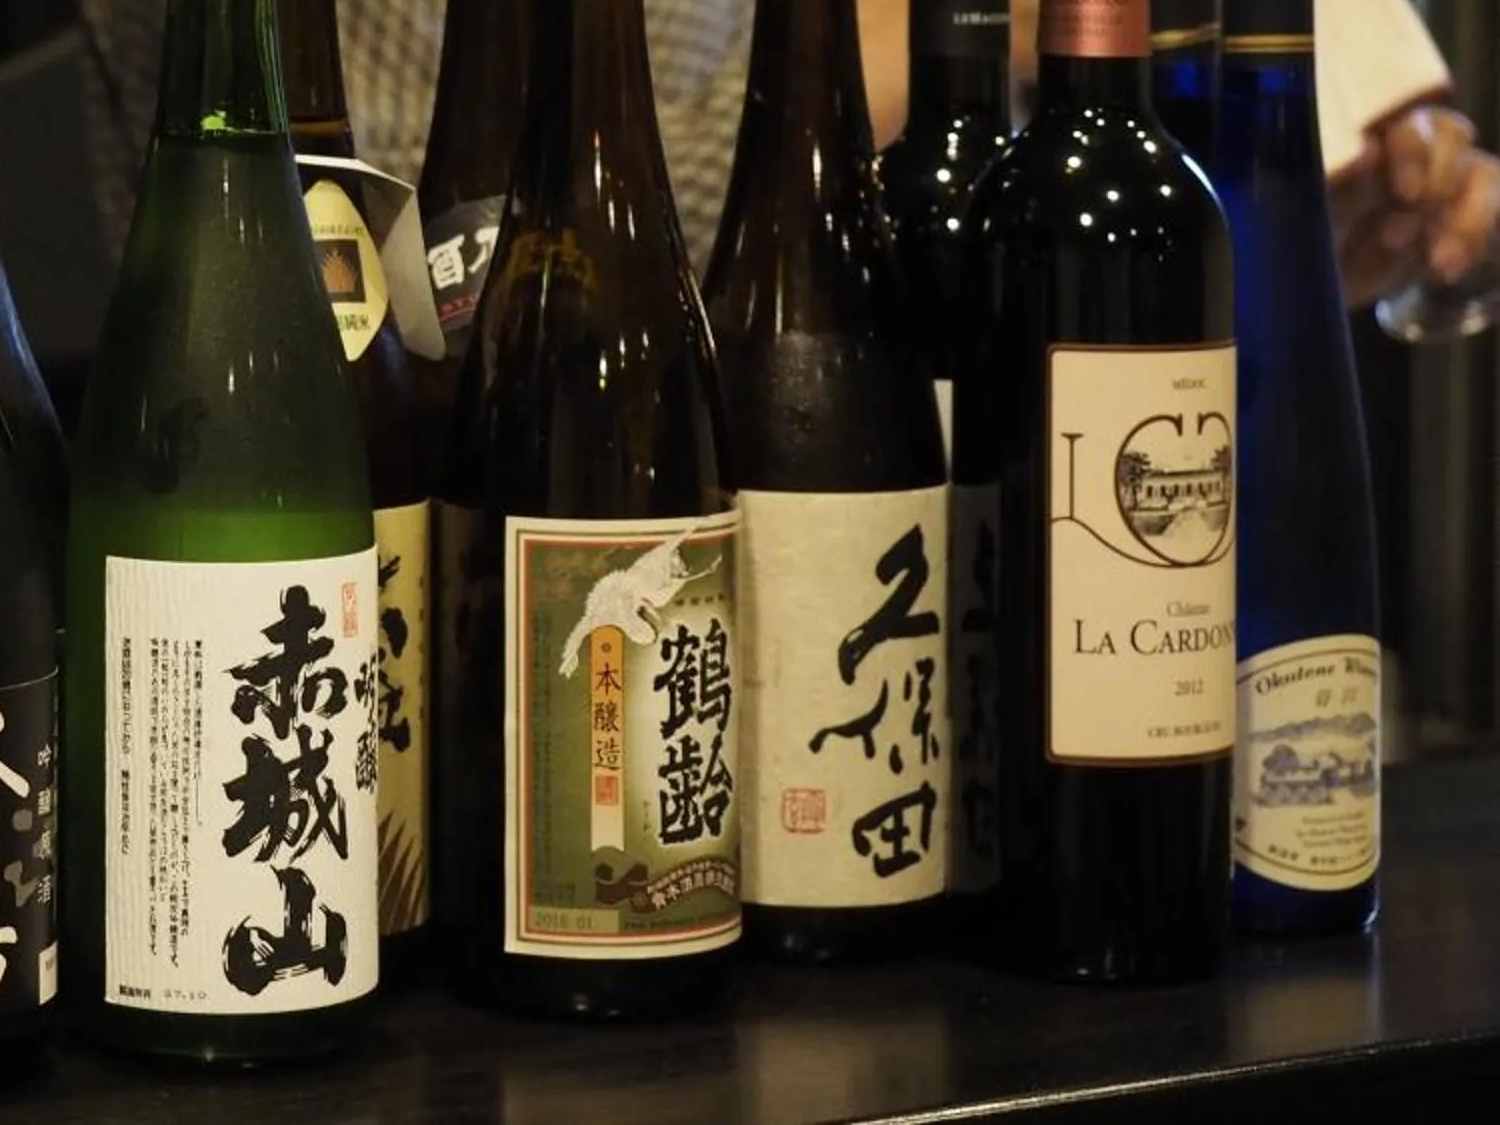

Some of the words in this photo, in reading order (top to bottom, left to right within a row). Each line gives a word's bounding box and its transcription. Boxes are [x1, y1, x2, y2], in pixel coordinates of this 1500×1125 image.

[222, 583, 348, 996] 赤城山
[808, 523, 941, 879] 久保田
[1174, 678, 1204, 696] 2012
